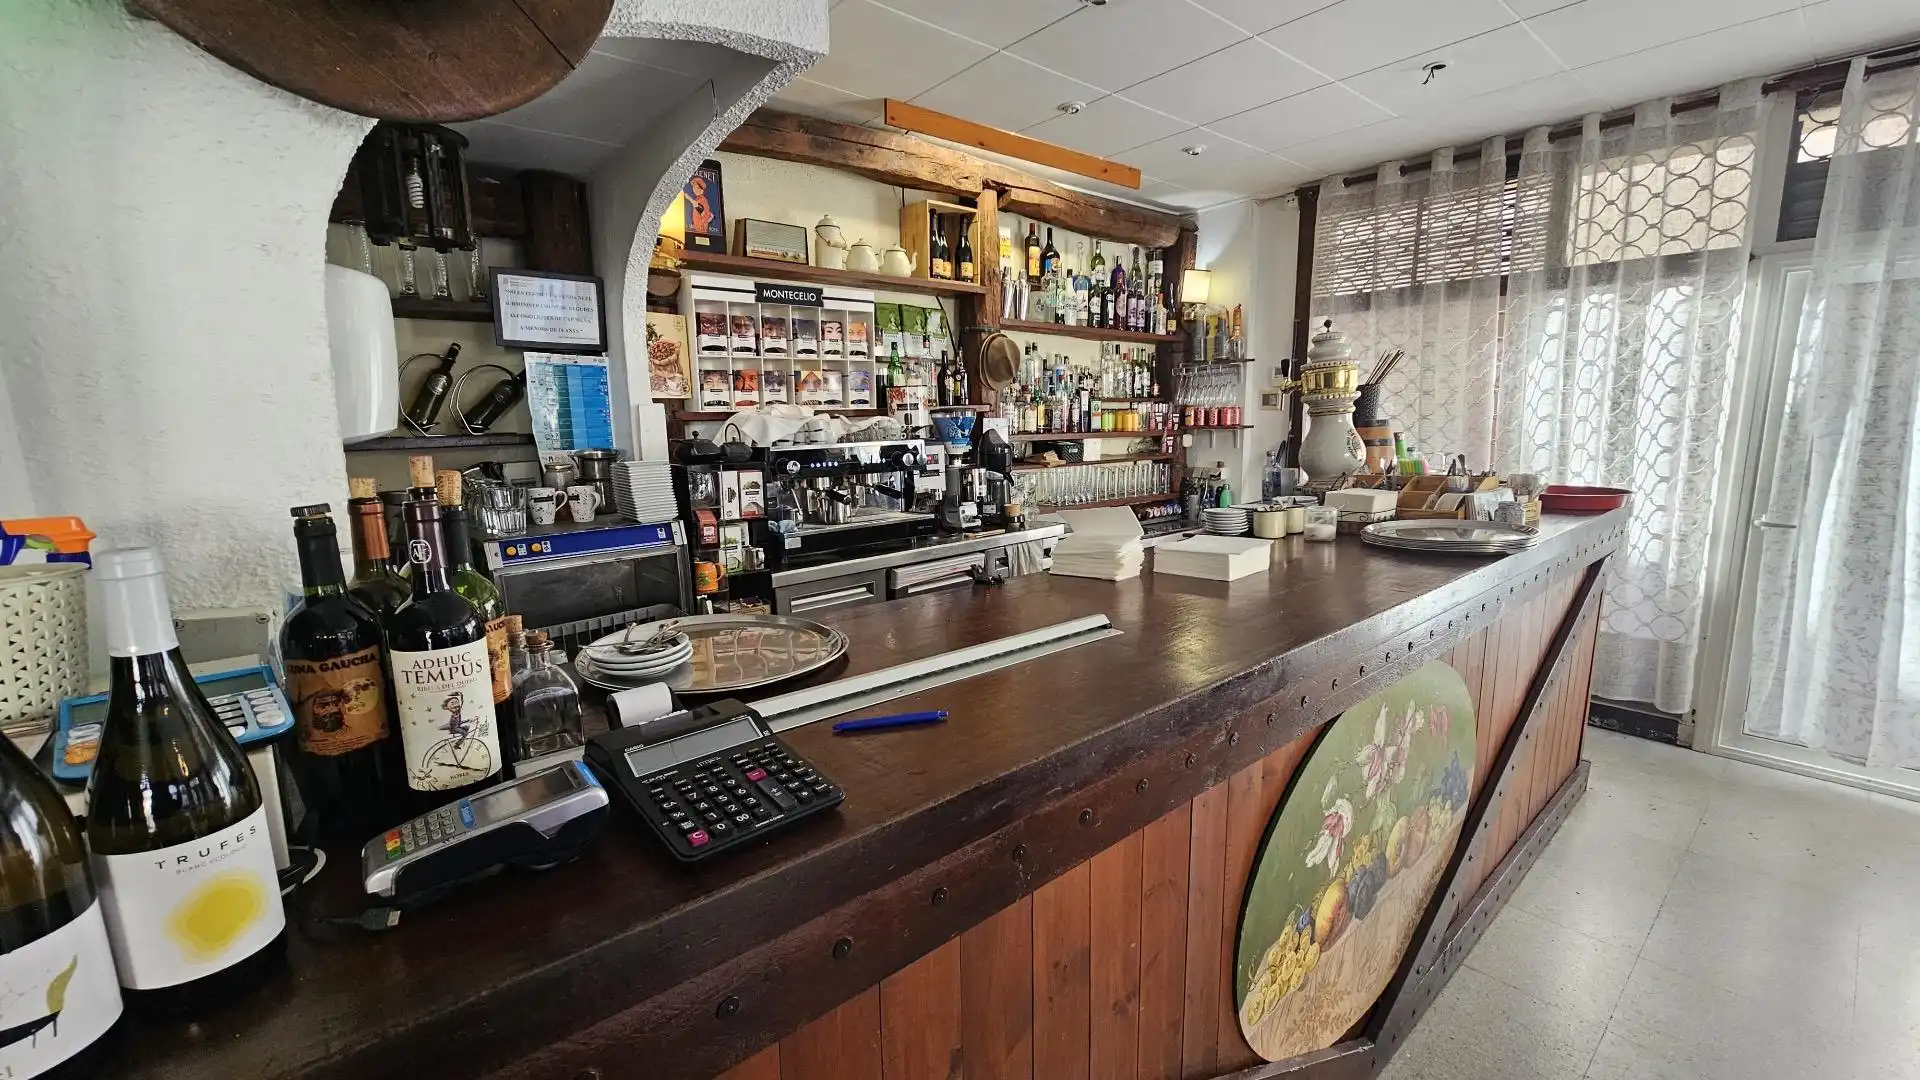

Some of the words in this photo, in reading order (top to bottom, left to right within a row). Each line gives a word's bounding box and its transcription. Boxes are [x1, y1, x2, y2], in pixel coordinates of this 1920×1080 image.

[763, 289, 817, 302] MONTECELIO
[319, 653, 376, 672] GAUCHA
[412, 652, 472, 670] ADHUC
[401, 659, 483, 684] TEMPUS
[624, 743, 644, 753] CASIO
[692, 831, 703, 839] C
[736, 813, 749, 822] 00
[154, 825, 256, 870] TRUFES
